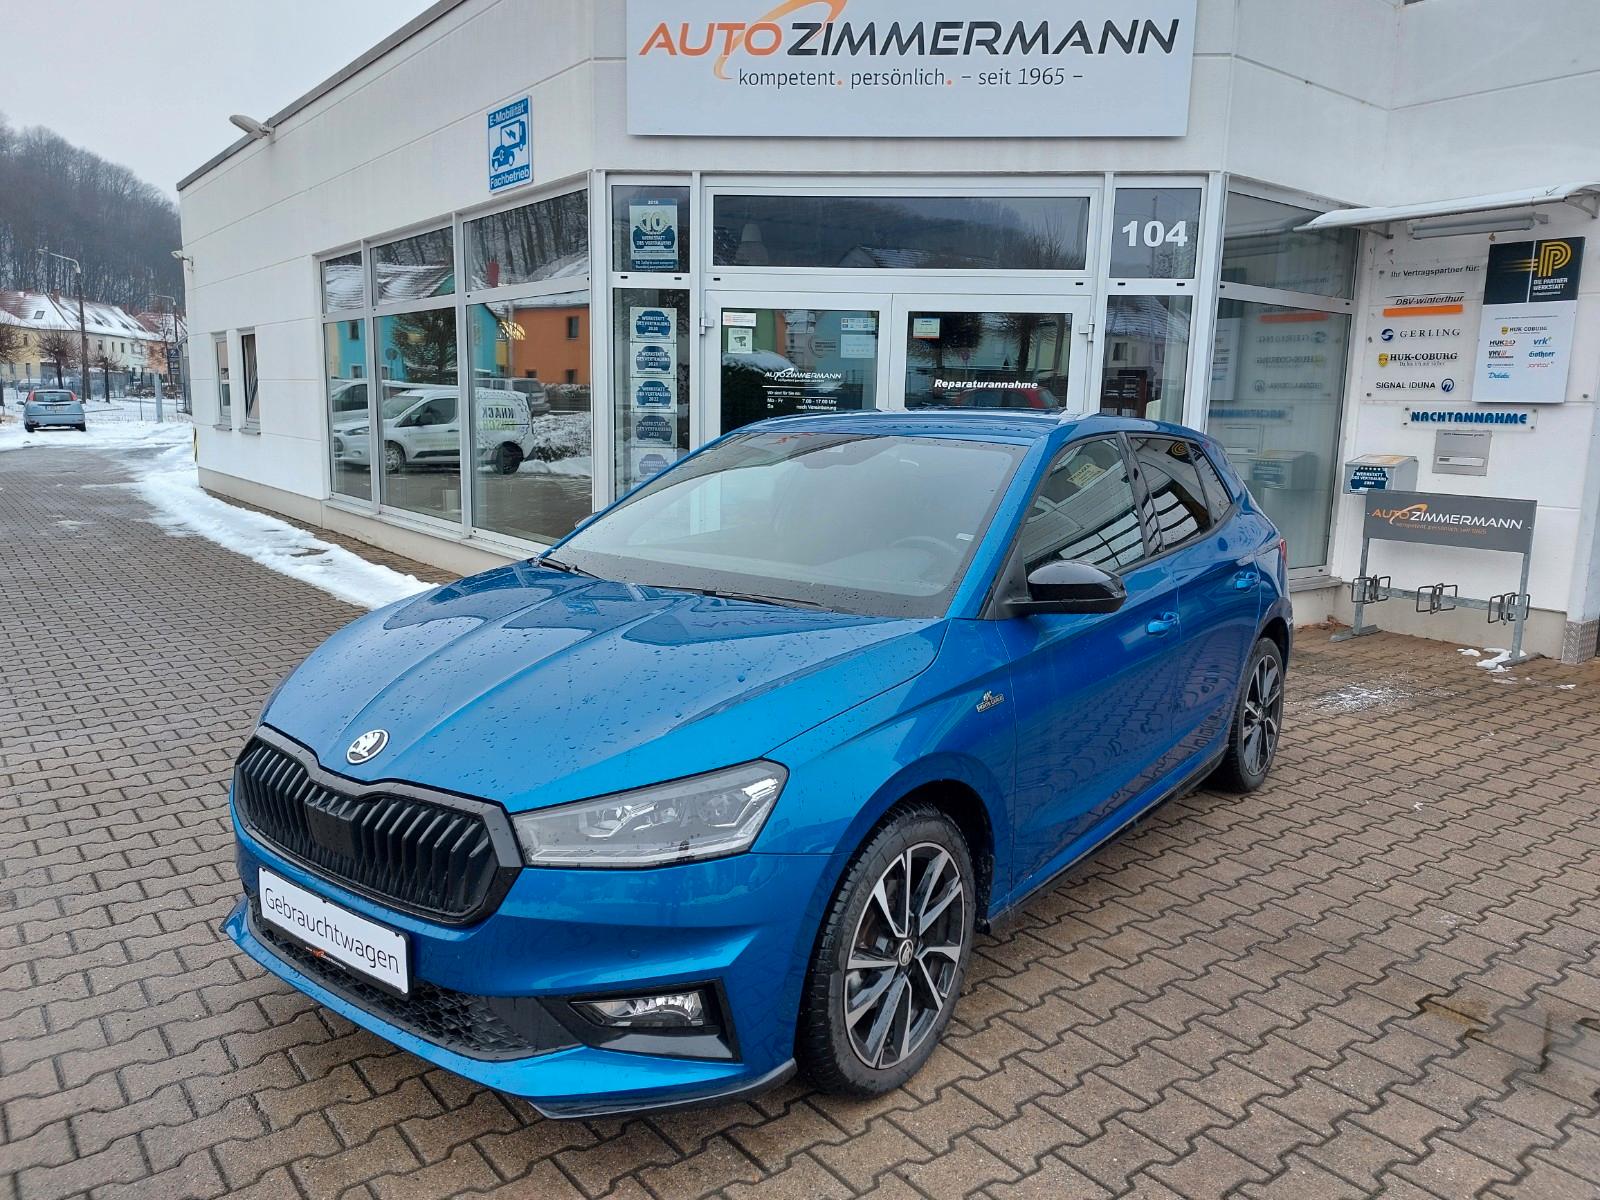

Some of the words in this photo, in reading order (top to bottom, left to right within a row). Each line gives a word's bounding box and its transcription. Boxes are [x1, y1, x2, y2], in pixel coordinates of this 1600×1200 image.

[739, 68, 843, 89] kompetent.
[851, 68, 952, 89] persönlich.
[978, 68, 1011, 85] seit
[1018, 67, 1065, 85] 1965
[489, 103, 525, 126] E-Mobilität
[490, 167, 530, 187] Fachbetrieb
[1122, 220, 1188, 247] 104
[1403, 266, 1463, 277] Vertragspartner
[1533, 283, 1564, 291] WERKSTATT
[1400, 328, 1461, 338] GERLING
[1390, 352, 1458, 361] HUK-COBURG
[934, 379, 1038, 390] Reparaturannahme
[1376, 381, 1407, 389] SIGNAL
[1408, 381, 1436, 389] IDUNA
[1411, 411, 1528, 425] NACHTANNAHME
[264, 887, 400, 974] Gebrauchtwagen
